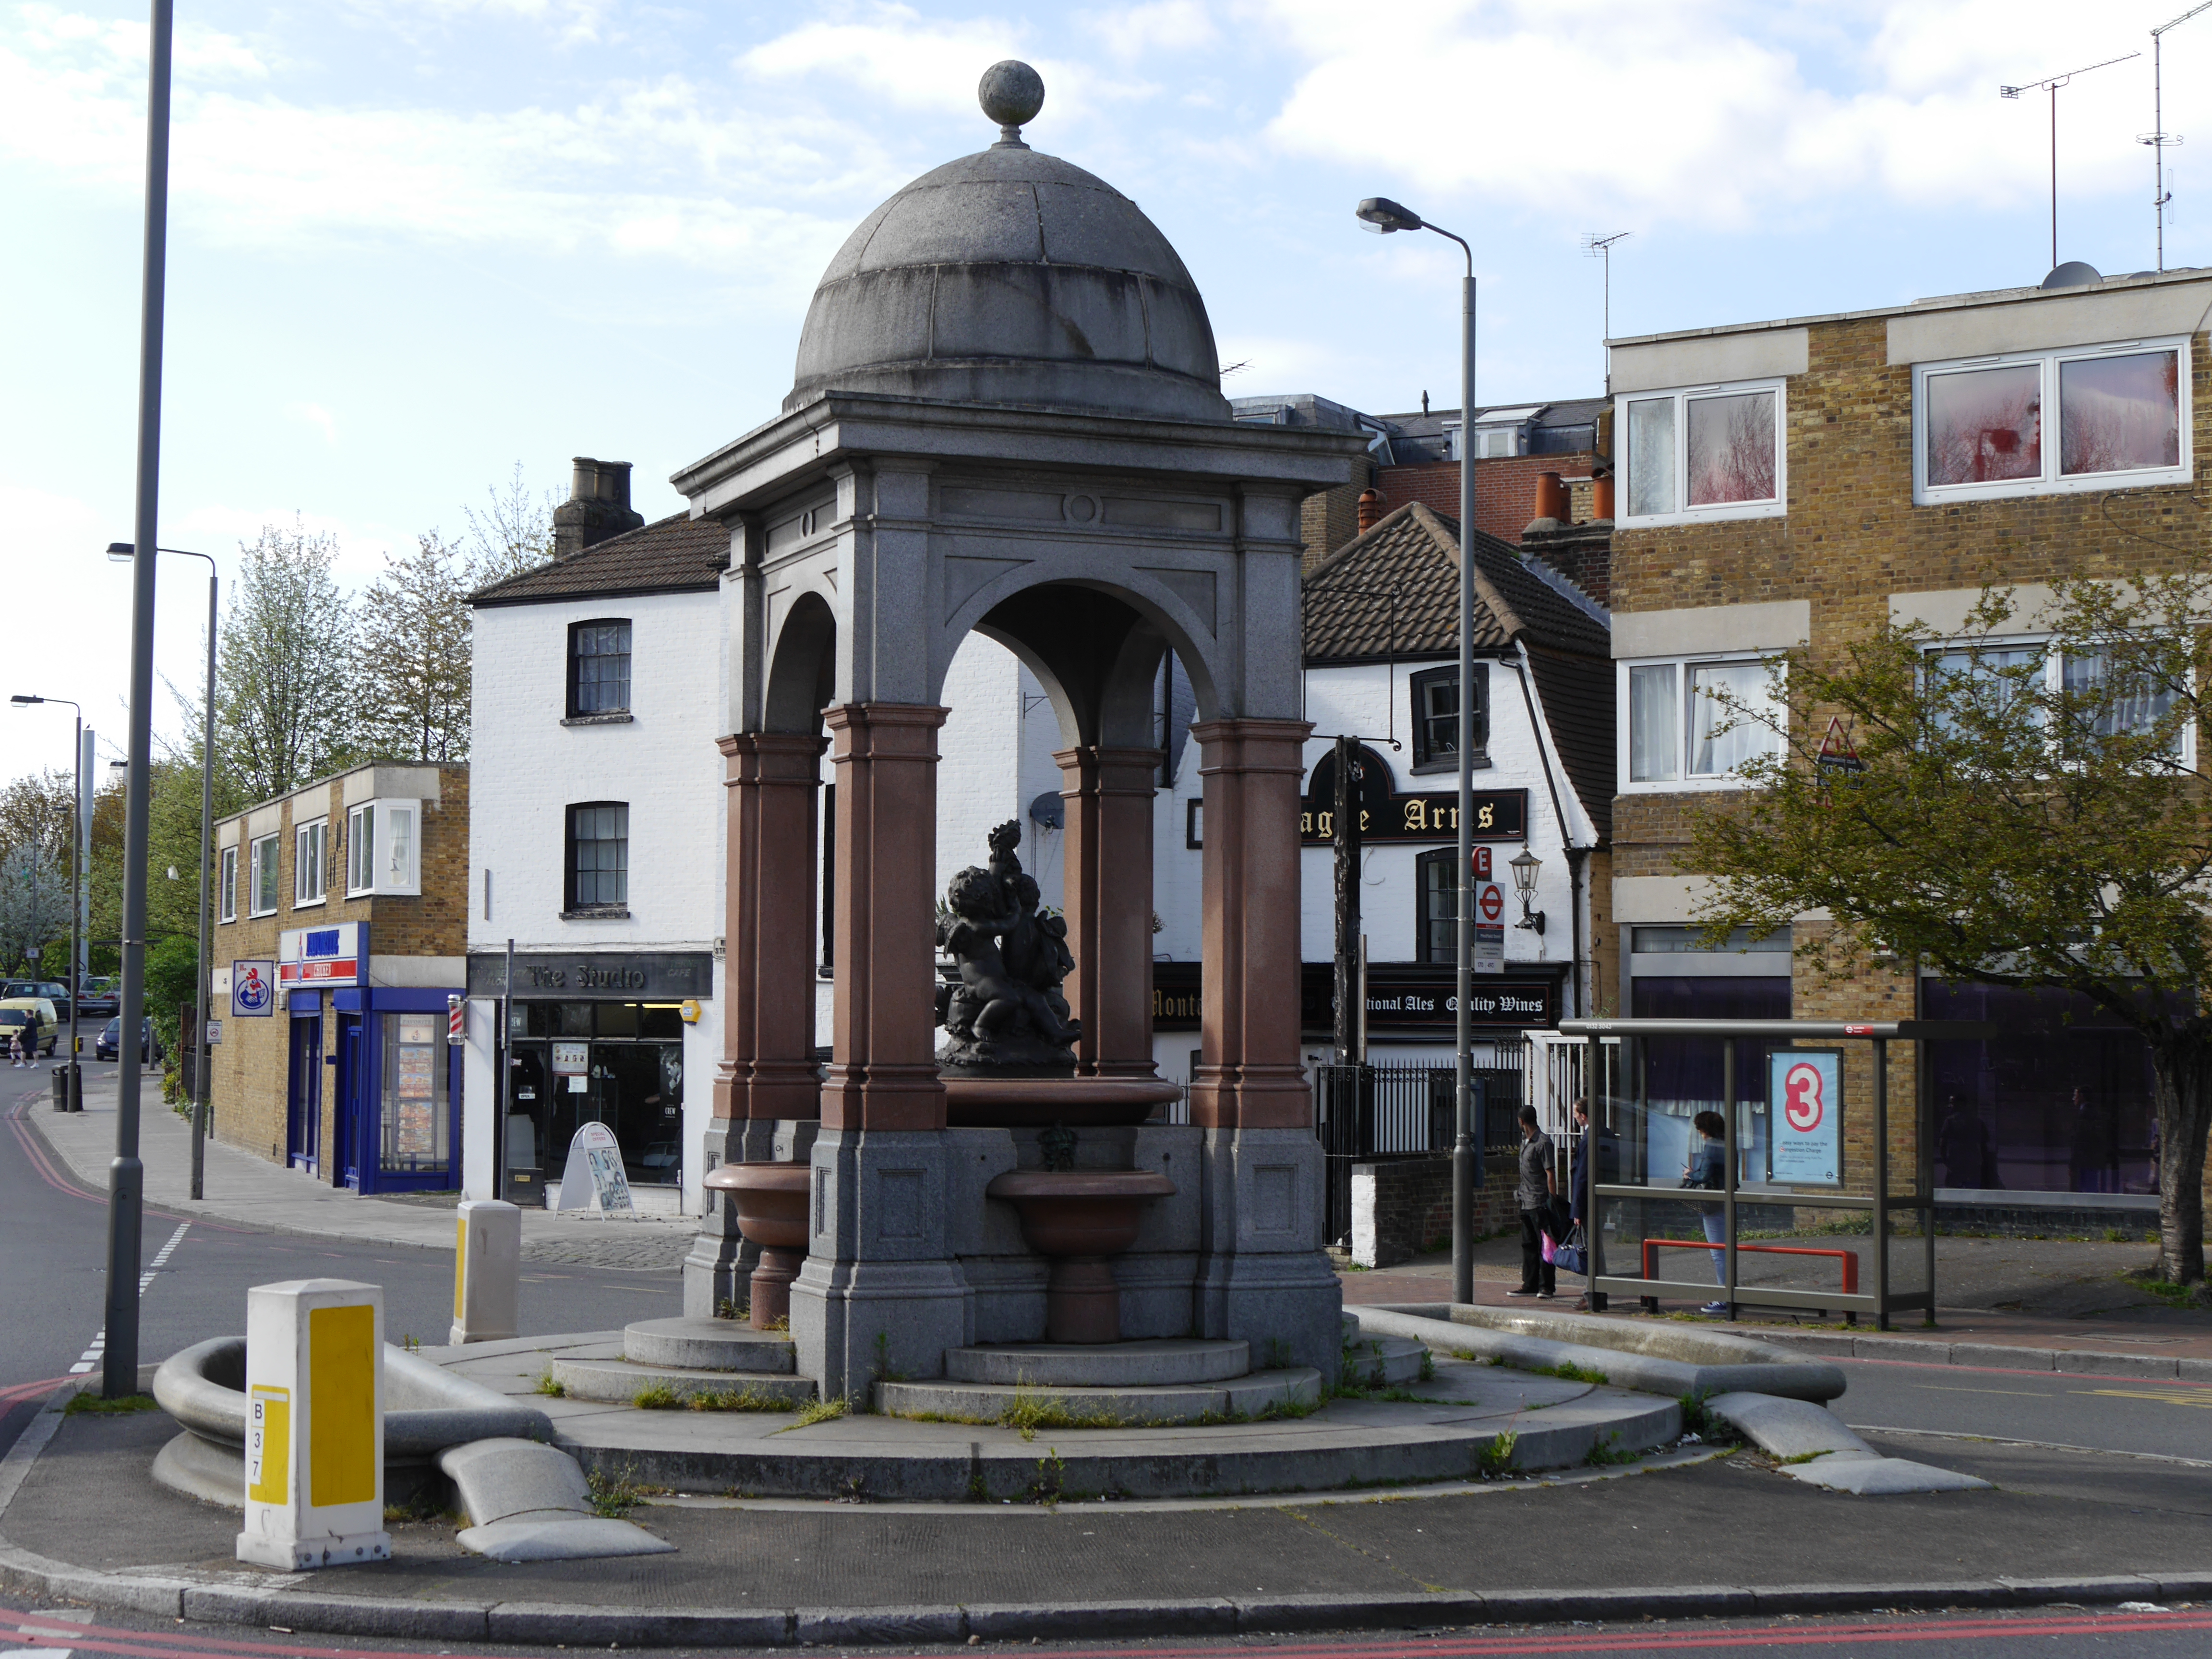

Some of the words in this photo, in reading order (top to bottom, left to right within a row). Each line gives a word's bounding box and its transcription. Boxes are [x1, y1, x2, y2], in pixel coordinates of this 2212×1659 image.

[1479, 851, 1488, 871] E
[526, 965, 564, 986] The
[576, 965, 645, 987] Studio
[1405, 995, 1434, 1011] Ales
[1445, 996, 1496, 1014] Qlity
[1499, 996, 1543, 1012] Wines
[1788, 1066, 1820, 1129] 3
[664, 1106, 676, 1115] CREW
